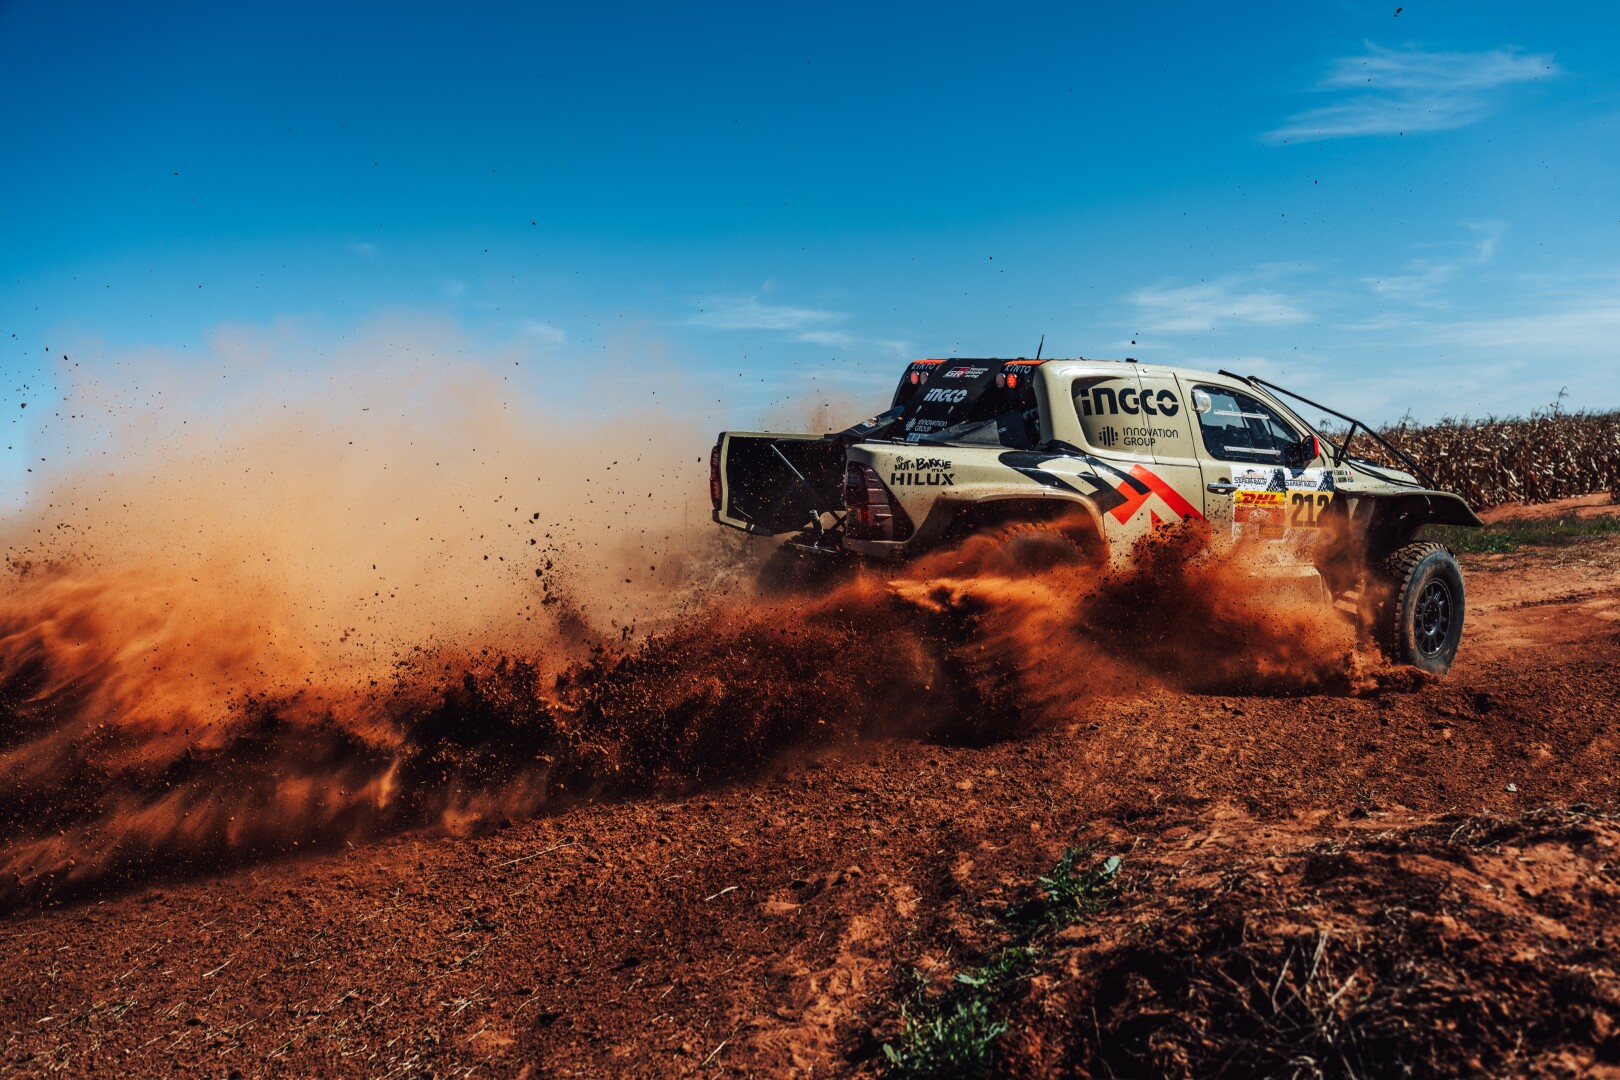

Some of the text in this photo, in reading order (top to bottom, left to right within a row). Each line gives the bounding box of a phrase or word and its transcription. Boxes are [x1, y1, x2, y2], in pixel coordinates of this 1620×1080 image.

[1004, 364, 1032, 373] KINTO
[1123, 437, 1156, 446] GROUP
[894, 460, 911, 471] NOT
[890, 473, 955, 486] HILUX
[1242, 494, 1278, 505] DHL
[1291, 493, 1330, 527] 212
